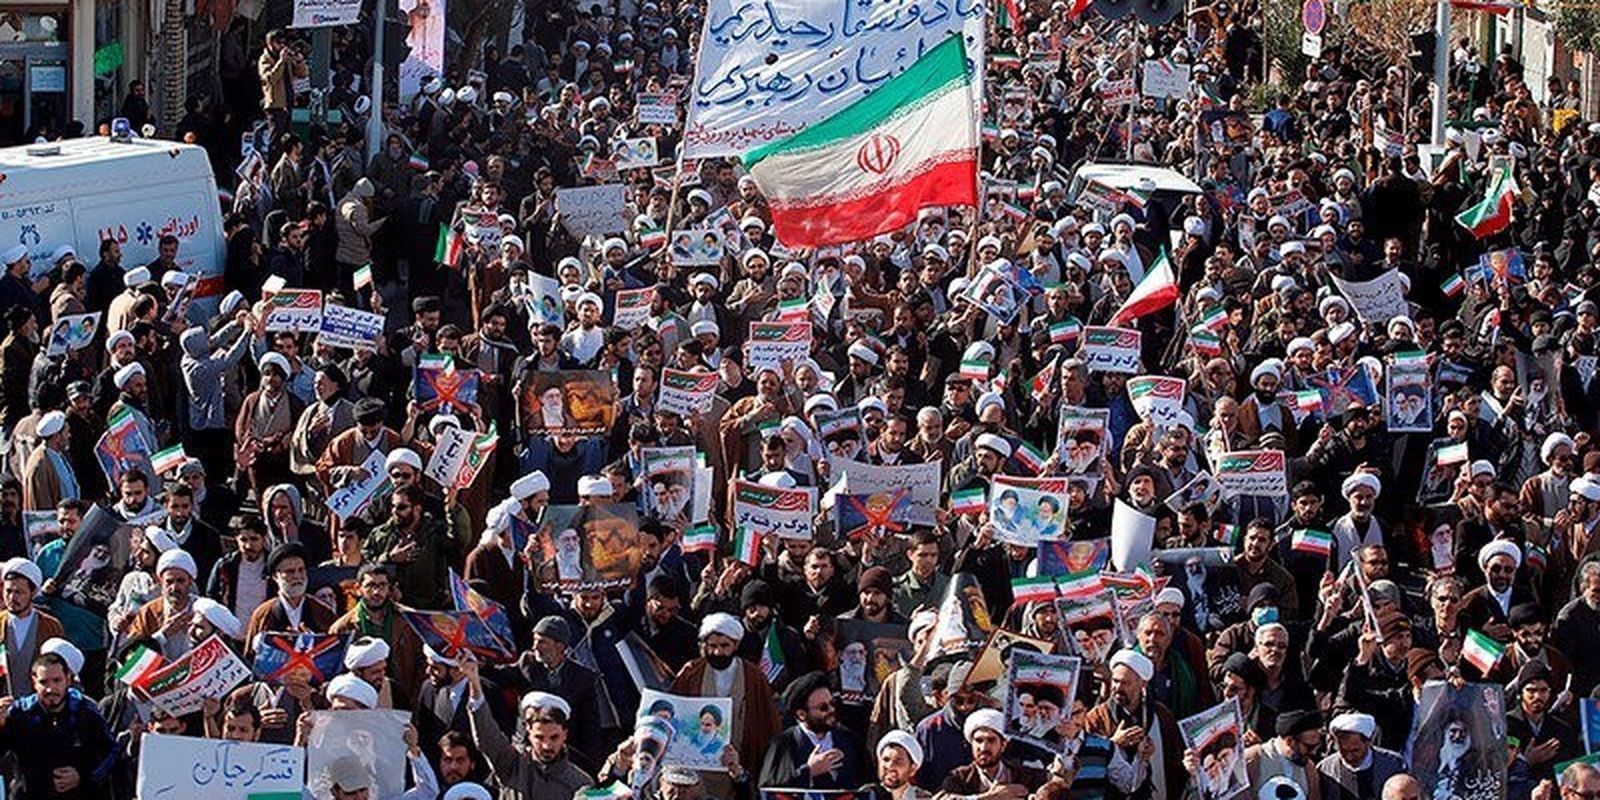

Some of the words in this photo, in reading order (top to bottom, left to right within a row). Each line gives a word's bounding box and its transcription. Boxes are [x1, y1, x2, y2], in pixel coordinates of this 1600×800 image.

[696, 65, 812, 107] رهبریم
[302, 315, 319, 327] مرگ
[739, 512, 750, 524] گر
[751, 515, 769, 527] فتنه
[772, 521, 781, 533] بر
[784, 519, 809, 533] مرگ
